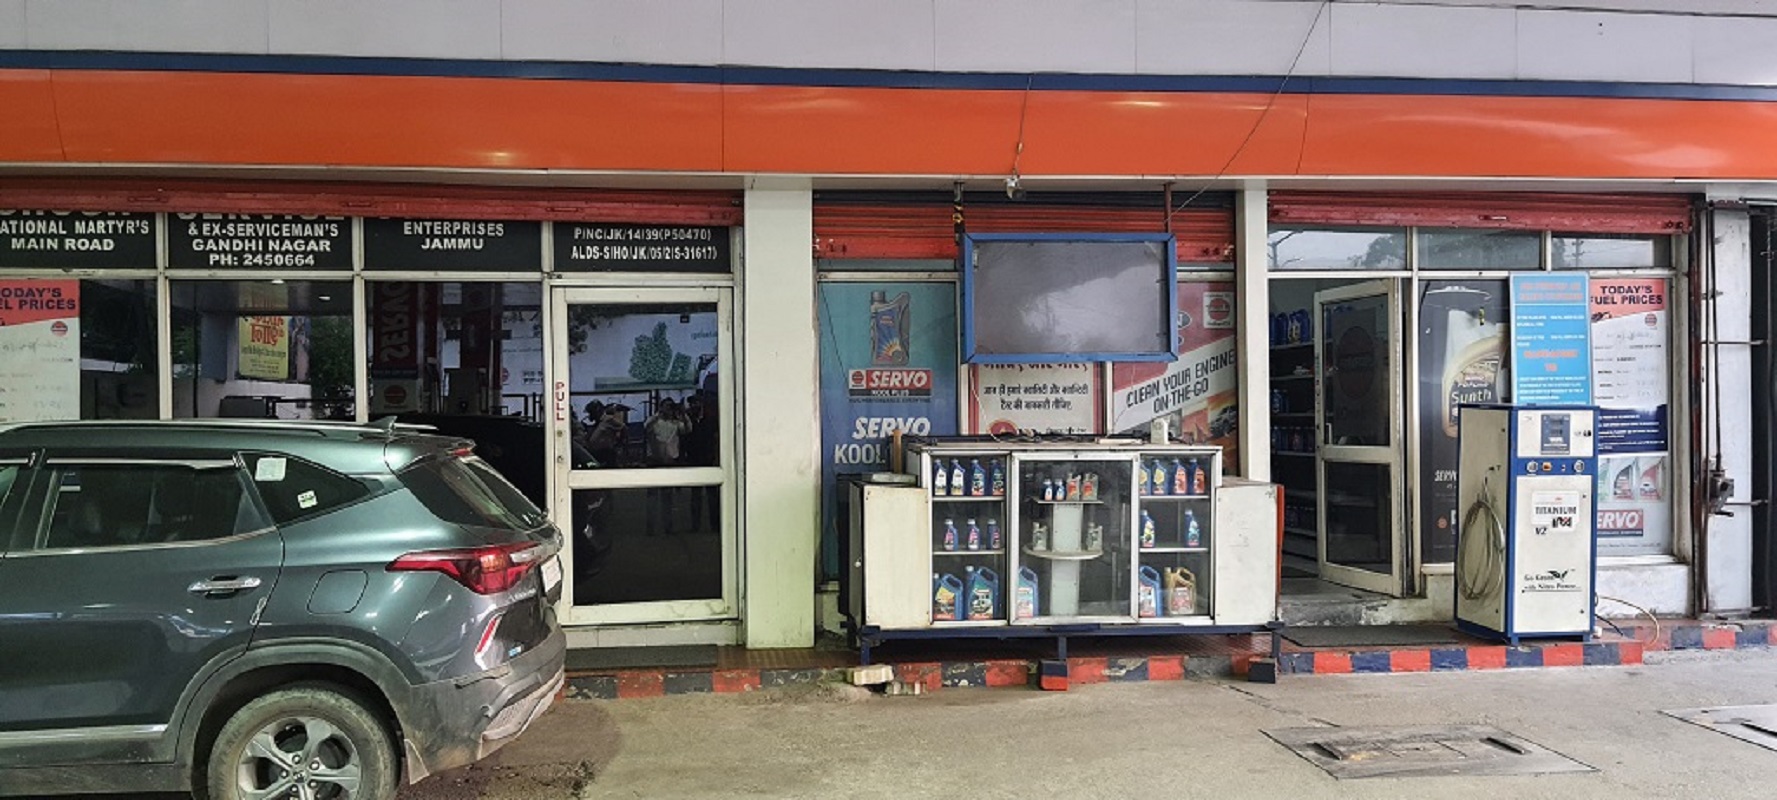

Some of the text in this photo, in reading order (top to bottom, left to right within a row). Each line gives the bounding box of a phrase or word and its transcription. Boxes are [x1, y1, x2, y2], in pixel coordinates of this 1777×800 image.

[75, 219, 150, 235] MARTYR'S
[188, 222, 339, 237] & EX-SERVICEMAN'S
[403, 221, 505, 236] ENTERPRISES
[11, 237, 115, 251] MAIN ROAD
[192, 238, 331, 252] GANDHI NAGAR
[421, 238, 485, 249] JAMMU
[209, 253, 315, 266] PH: 2450664
[1, 287, 62, 298] ODAY'S
[1600, 285, 1653, 294] TODAY'S
[18, 299, 76, 310] PRICES
[1590, 294, 1663, 305] UEL PRICES
[869, 370, 928, 388] SERVO
[1126, 349, 1235, 408] CLEAN YOUR ENGINE
[555, 381, 565, 421] PULL
[1153, 378, 1209, 413] ON-THE-GO
[852, 416, 931, 440] SERVO
[834, 443, 886, 464] KOOL
[1535, 506, 1577, 515] TITANIUM
[1597, 511, 1639, 529] ERVO
